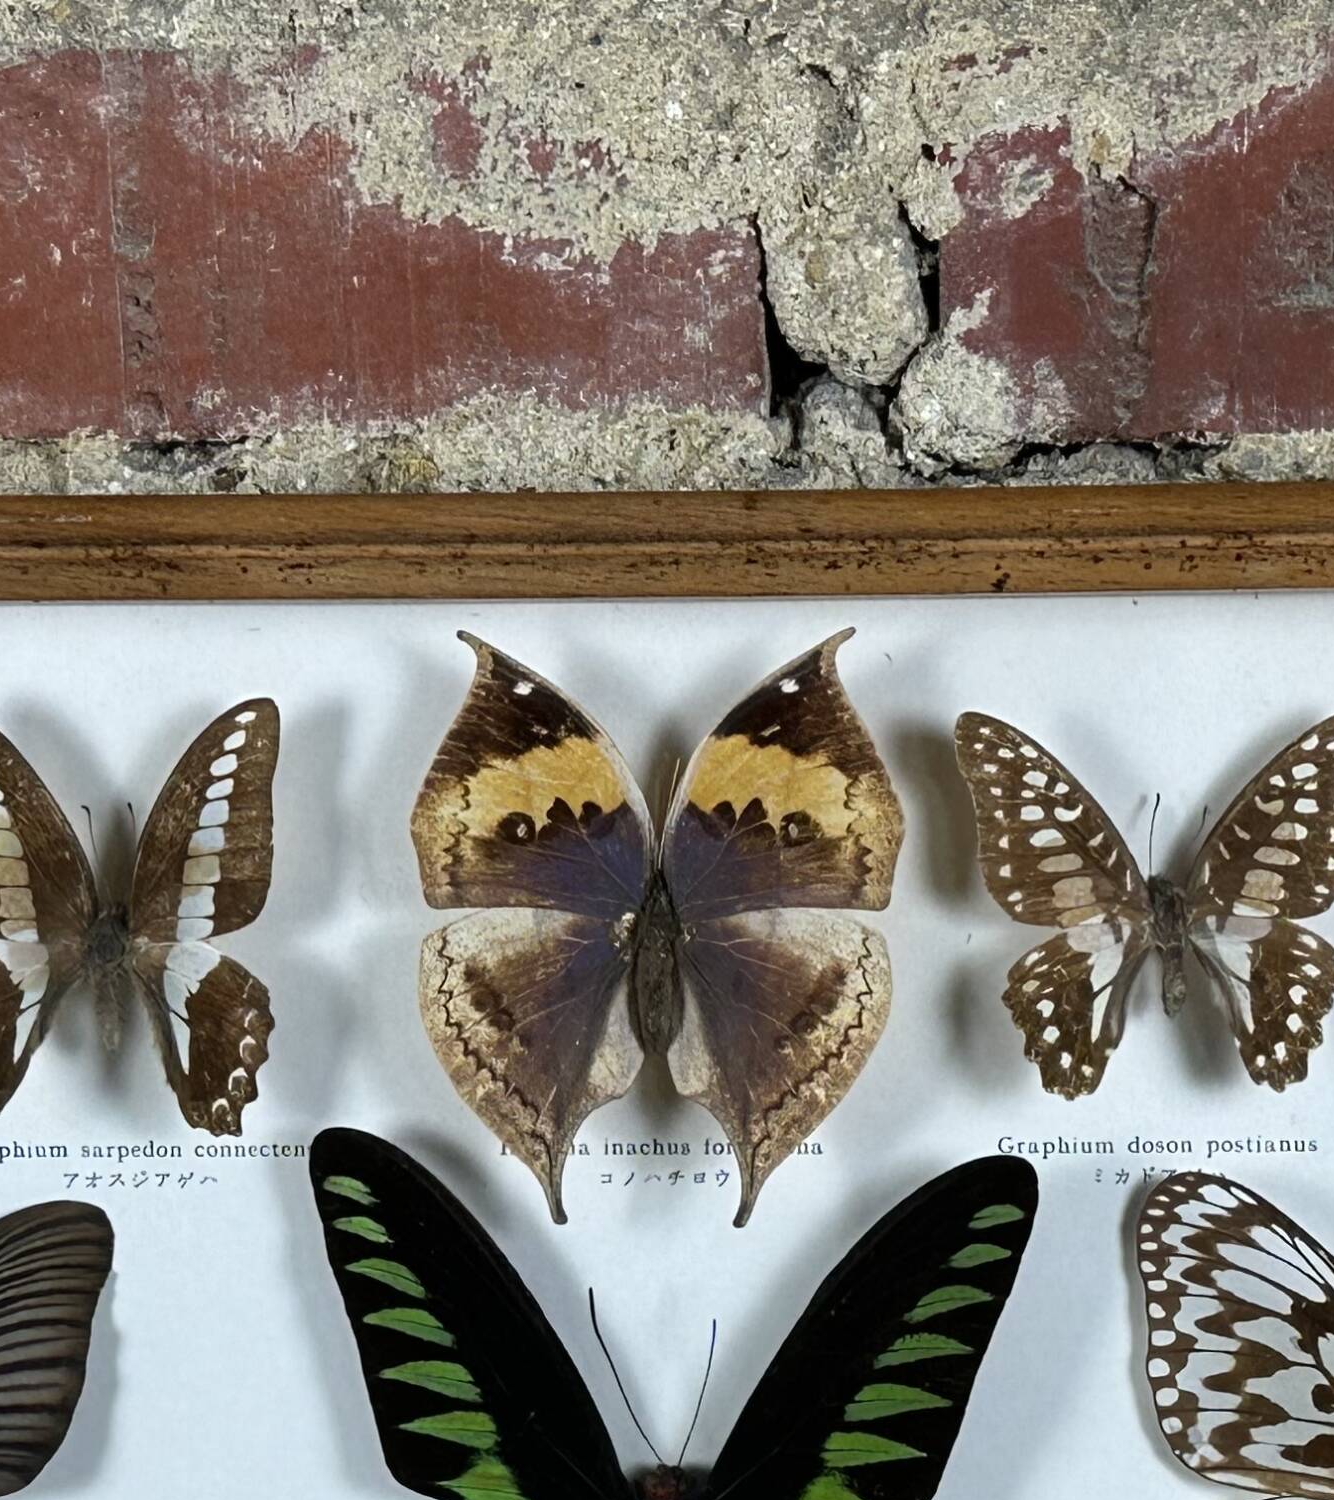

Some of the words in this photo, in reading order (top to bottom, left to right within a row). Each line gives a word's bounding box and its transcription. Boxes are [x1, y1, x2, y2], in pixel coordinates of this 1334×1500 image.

[80, 1140, 183, 1163] sarpedon
[194, 1143, 311, 1158] connecten
[603, 1137, 692, 1156] inachus
[997, 1136, 1115, 1159] Graphium
[1127, 1136, 1193, 1154] doson
[1206, 1134, 1318, 1158] postianus
